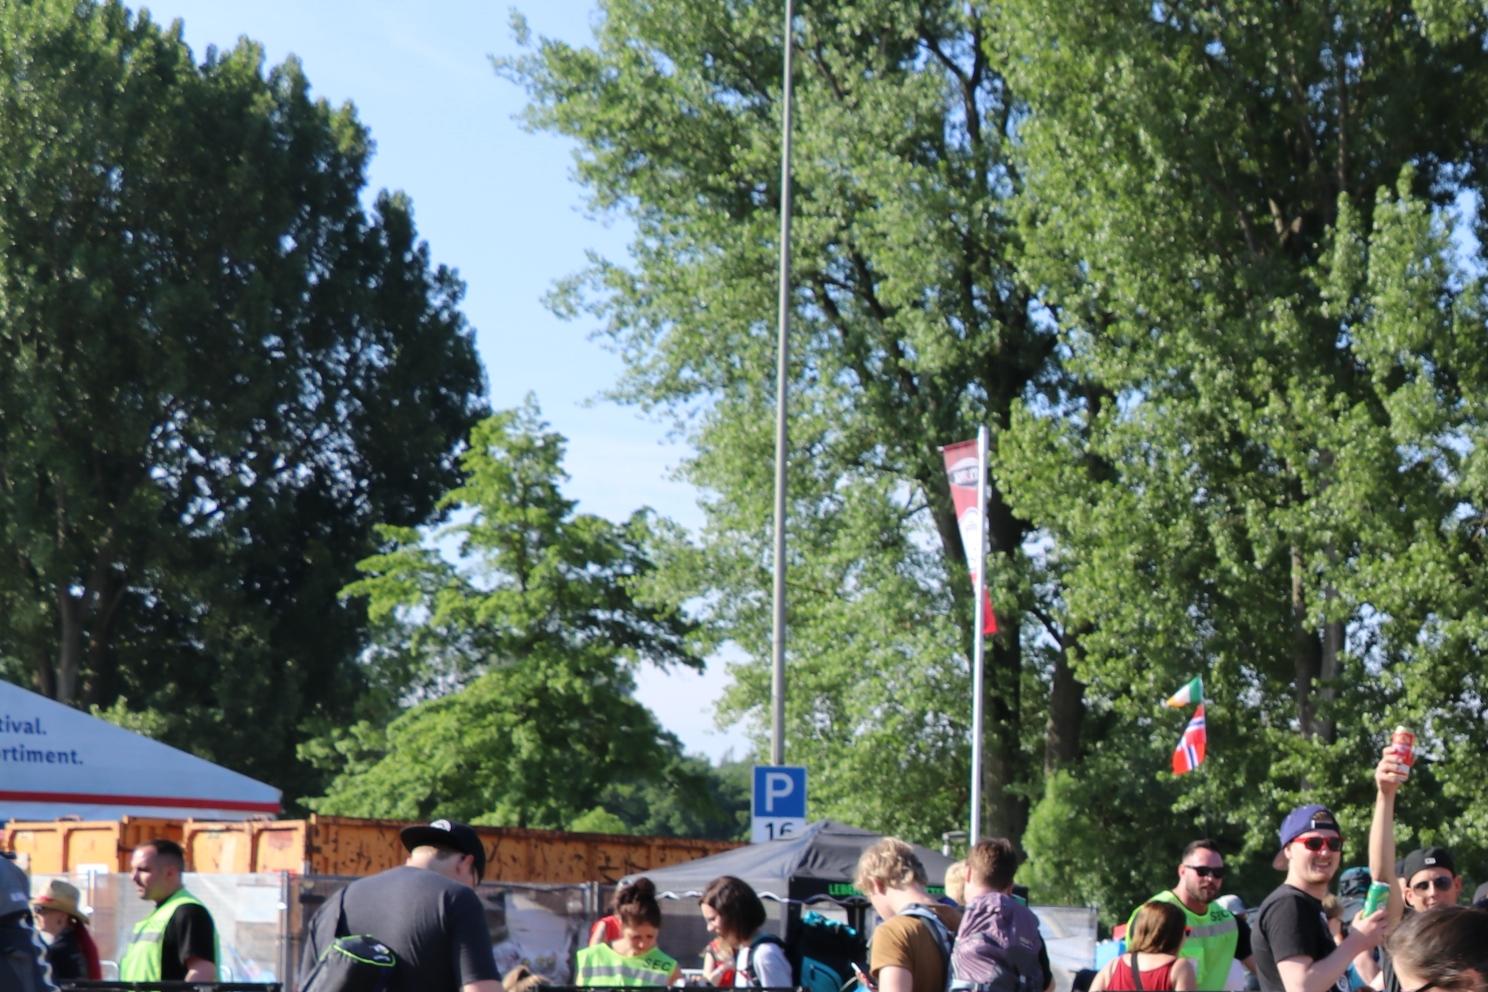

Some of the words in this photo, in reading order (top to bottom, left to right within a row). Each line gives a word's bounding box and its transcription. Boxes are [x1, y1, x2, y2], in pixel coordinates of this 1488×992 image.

[2, 744, 84, 765] rtiment.
[765, 772, 794, 812] P
[642, 957, 673, 972] SEC
